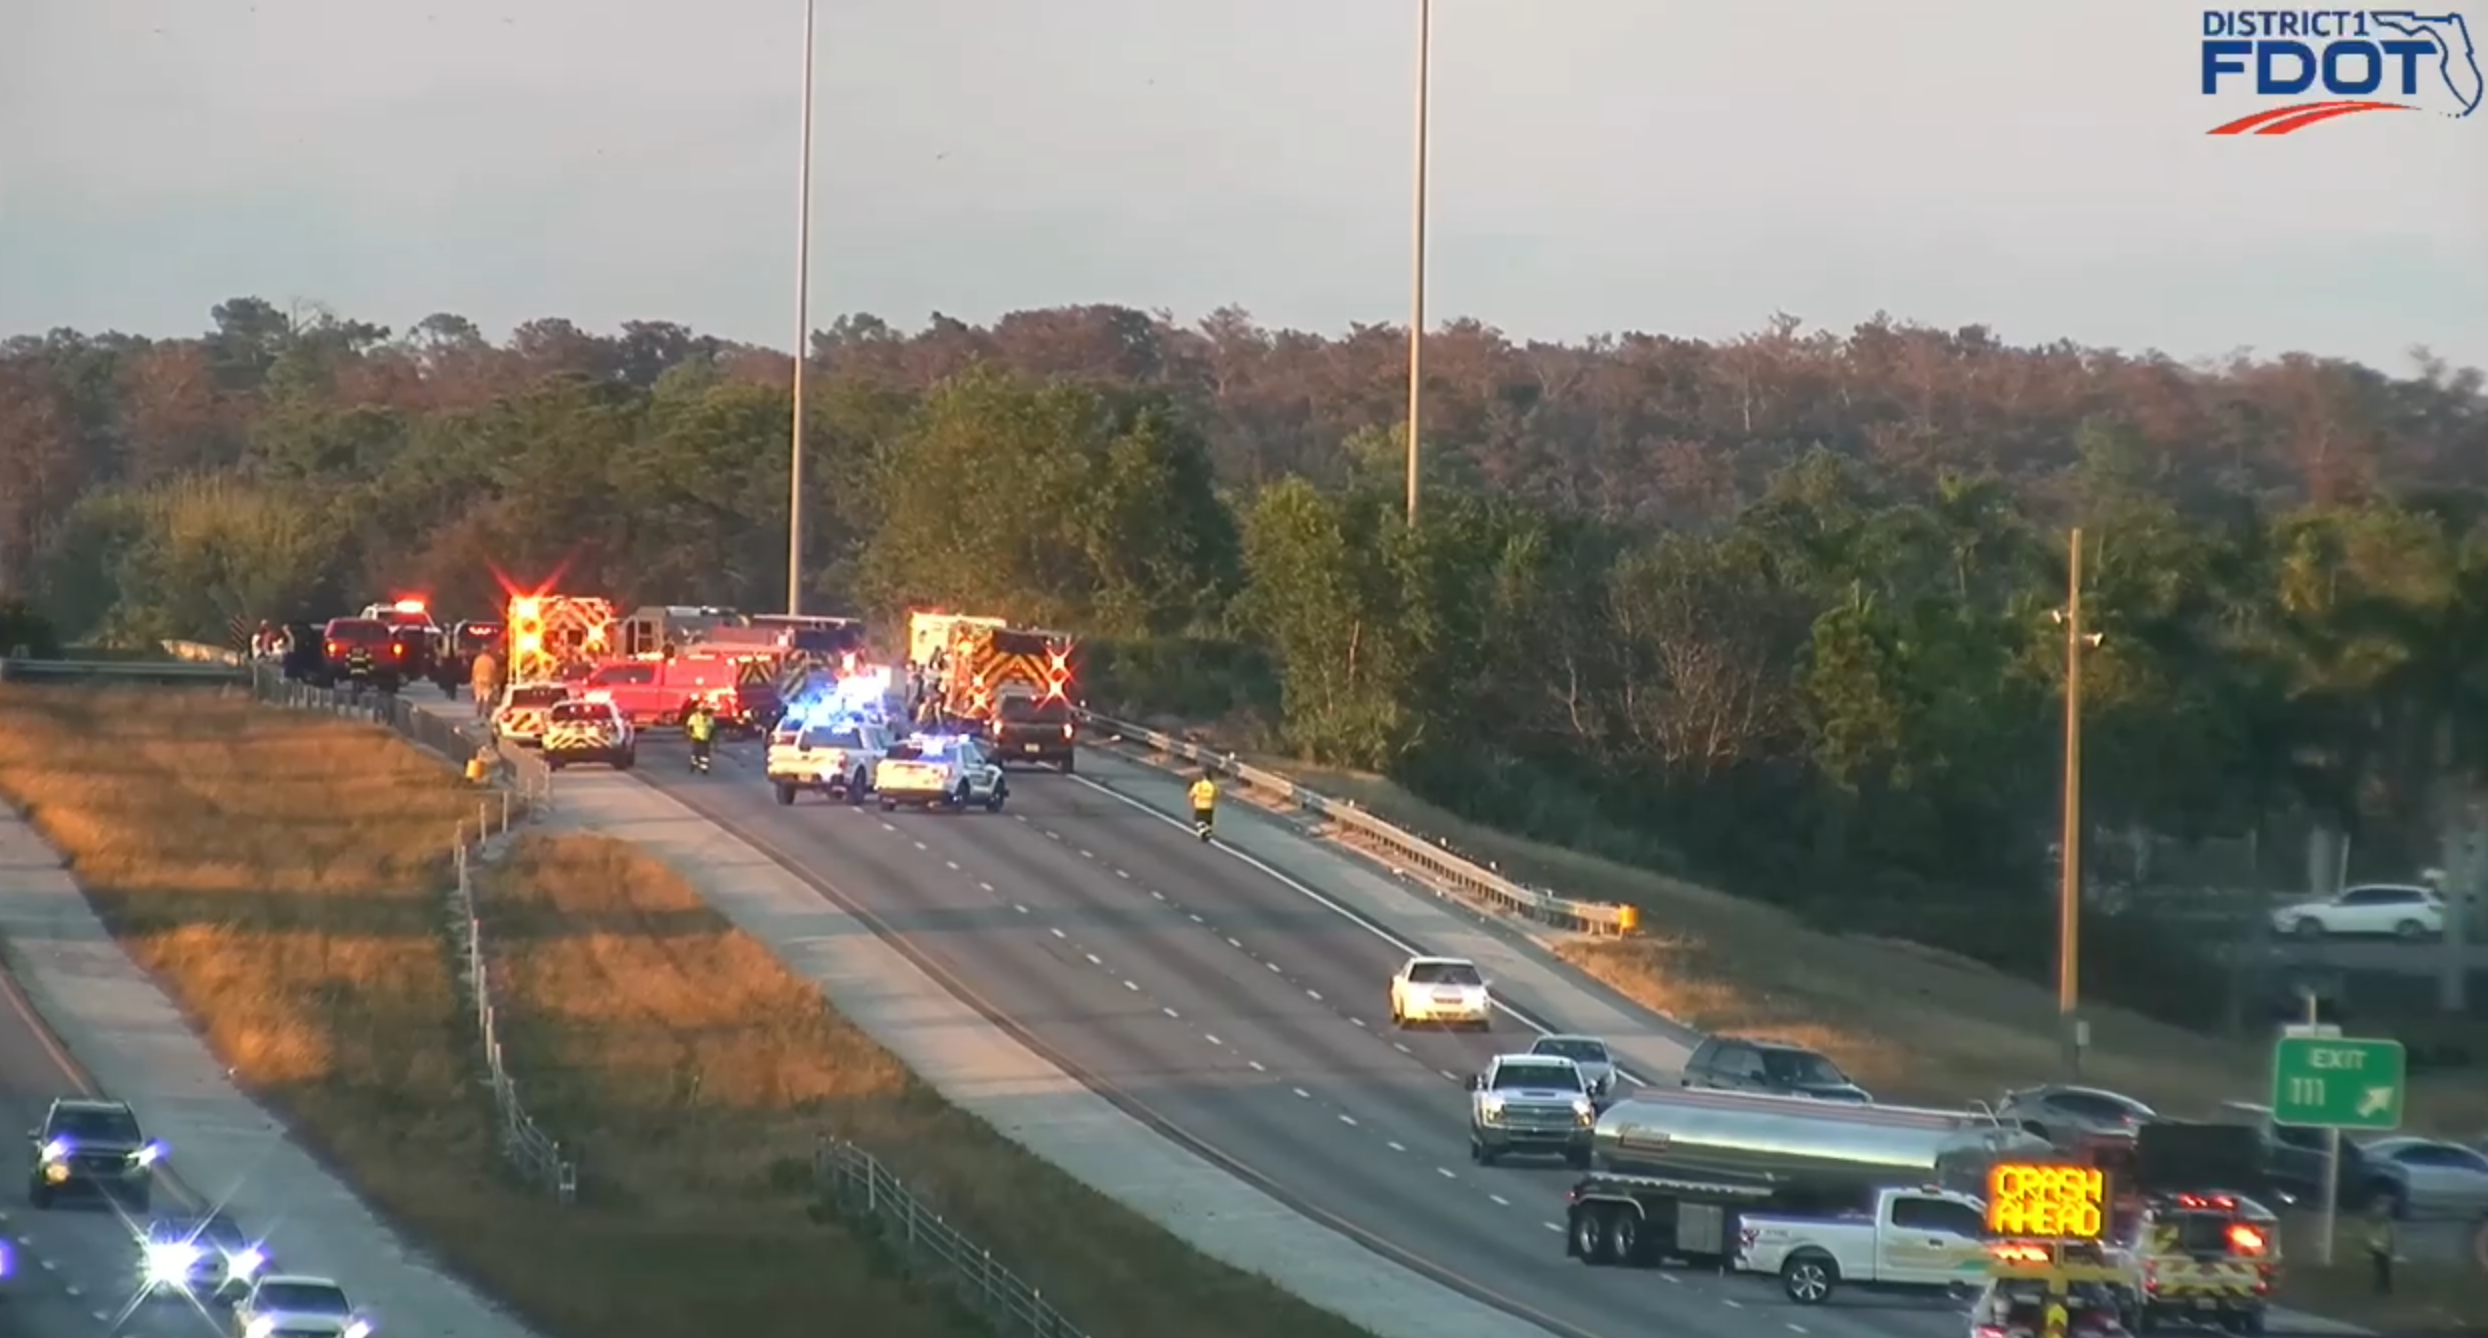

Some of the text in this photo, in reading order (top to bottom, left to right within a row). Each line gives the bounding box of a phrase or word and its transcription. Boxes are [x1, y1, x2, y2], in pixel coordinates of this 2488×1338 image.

[2310, 1047, 2368, 1070] EXIT
[2290, 1077, 2326, 1107] 111
[1996, 1164, 2103, 1202] CRASH
[1995, 1199, 2102, 1236] AHEAD
